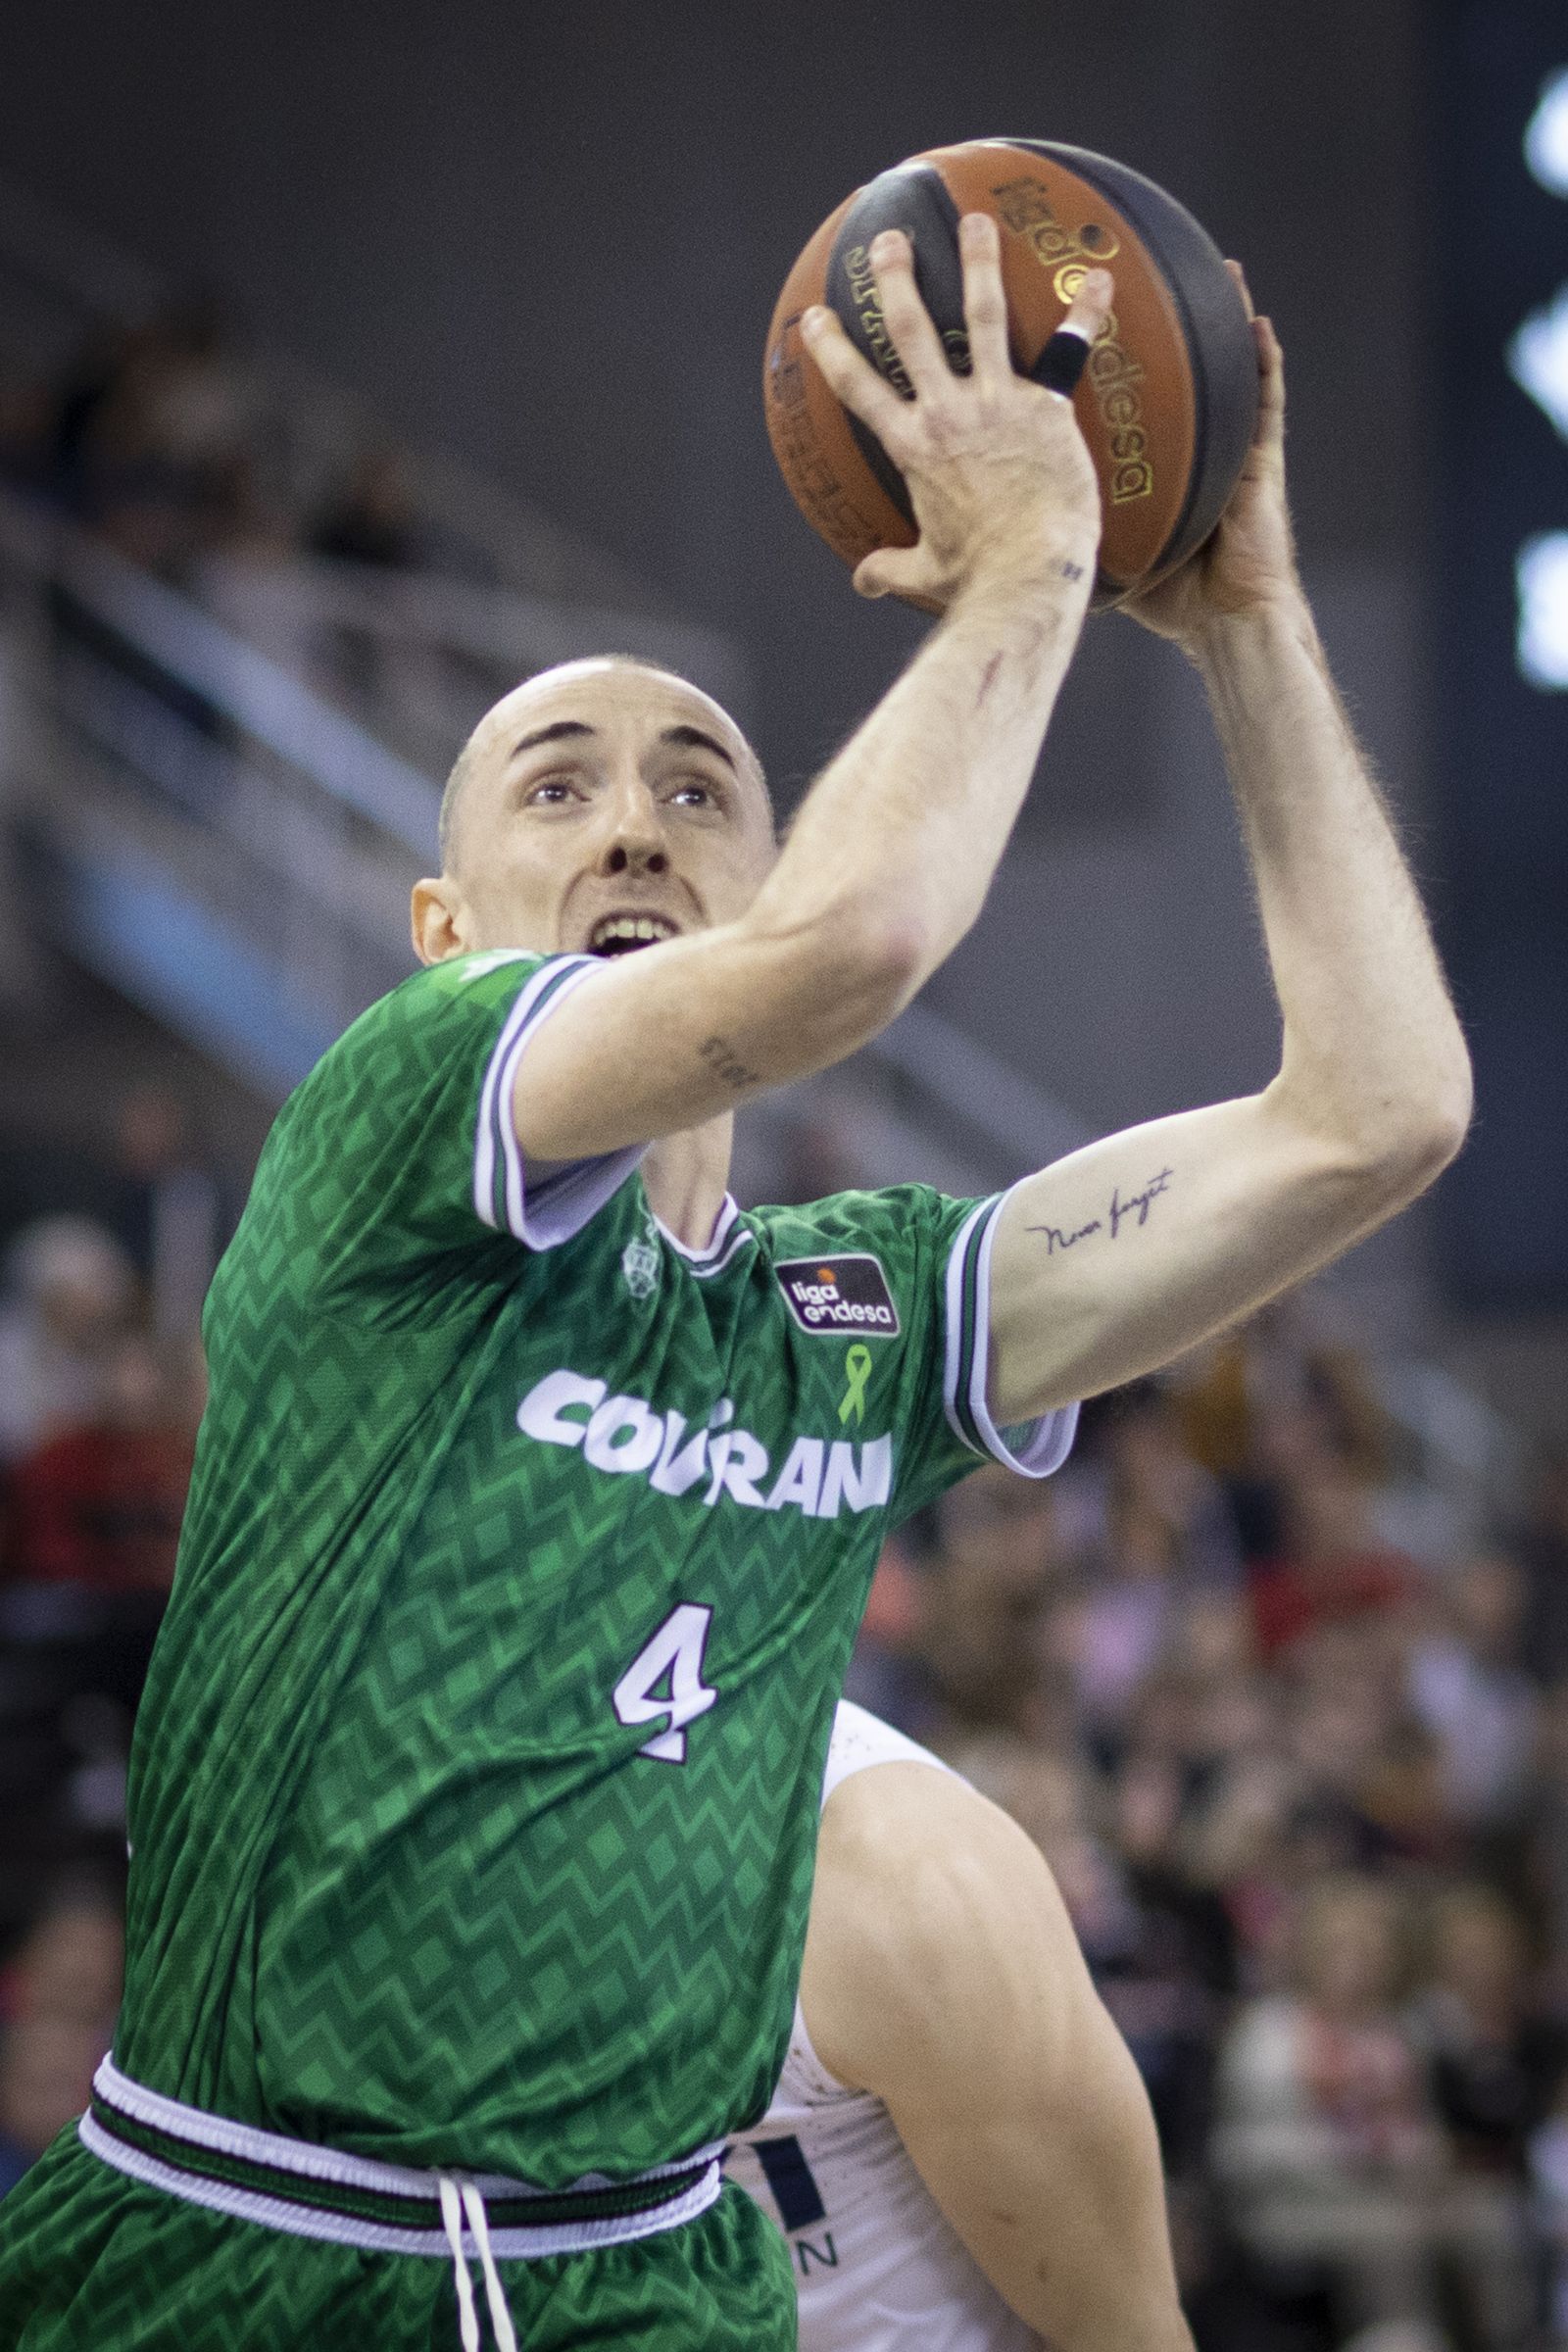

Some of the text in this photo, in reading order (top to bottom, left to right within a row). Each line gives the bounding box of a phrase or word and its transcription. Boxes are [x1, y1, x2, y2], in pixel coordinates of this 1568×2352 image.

[791, 1281, 840, 1305] liga
[804, 1299, 892, 1324] endesa
[515, 1368, 893, 1518] COVRAN
[612, 1599, 718, 1765] 4
